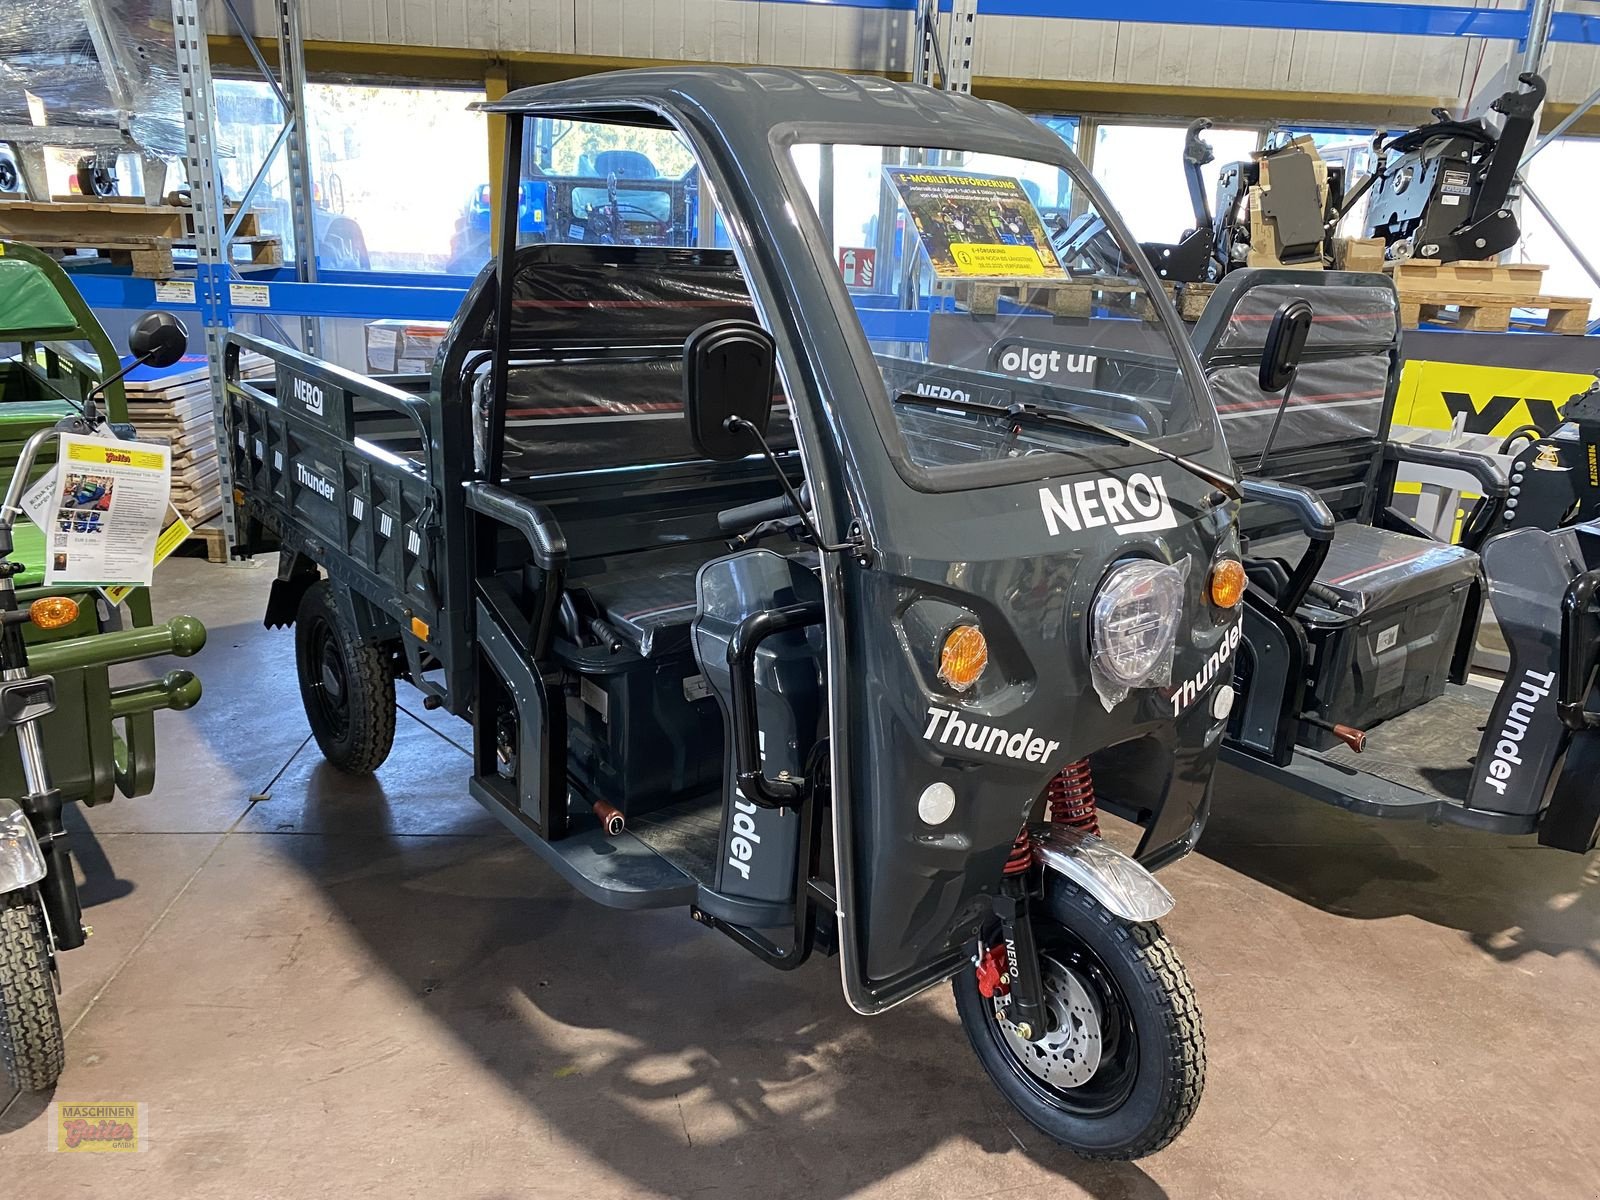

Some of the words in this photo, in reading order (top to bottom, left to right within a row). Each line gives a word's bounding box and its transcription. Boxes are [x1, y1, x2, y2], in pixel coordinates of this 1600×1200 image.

[1002, 348, 1061, 380] olgt
[294, 377, 323, 416] NERO
[296, 462, 335, 501] Thunder
[1039, 472, 1178, 536] NERO
[1171, 616, 1243, 718] Thunder
[923, 706, 1060, 764] Thunder
[1485, 669, 1556, 795] Thunder
[1005, 938, 1019, 978] NERO
